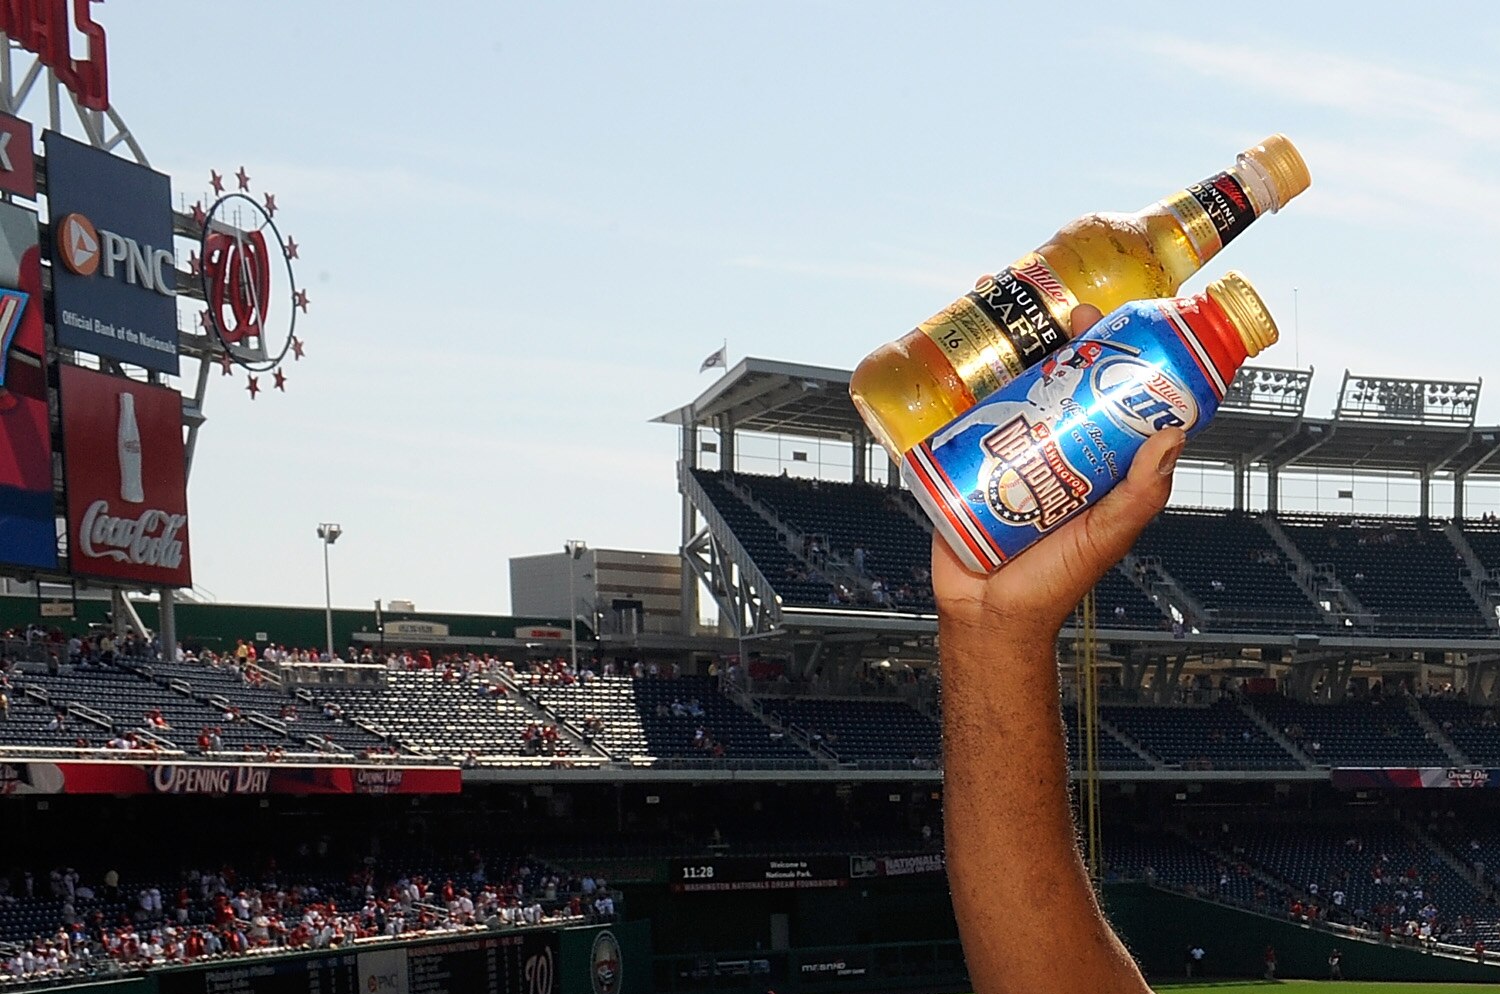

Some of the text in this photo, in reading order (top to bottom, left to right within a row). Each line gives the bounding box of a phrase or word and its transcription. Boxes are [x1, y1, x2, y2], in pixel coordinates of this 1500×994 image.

[100, 229, 177, 297] PNC
[1011, 258, 1070, 305] Miller
[62, 310, 176, 354] Official Bank of the Nationals
[943, 329, 963, 349] 16
[682, 866, 714, 879] 11:28
